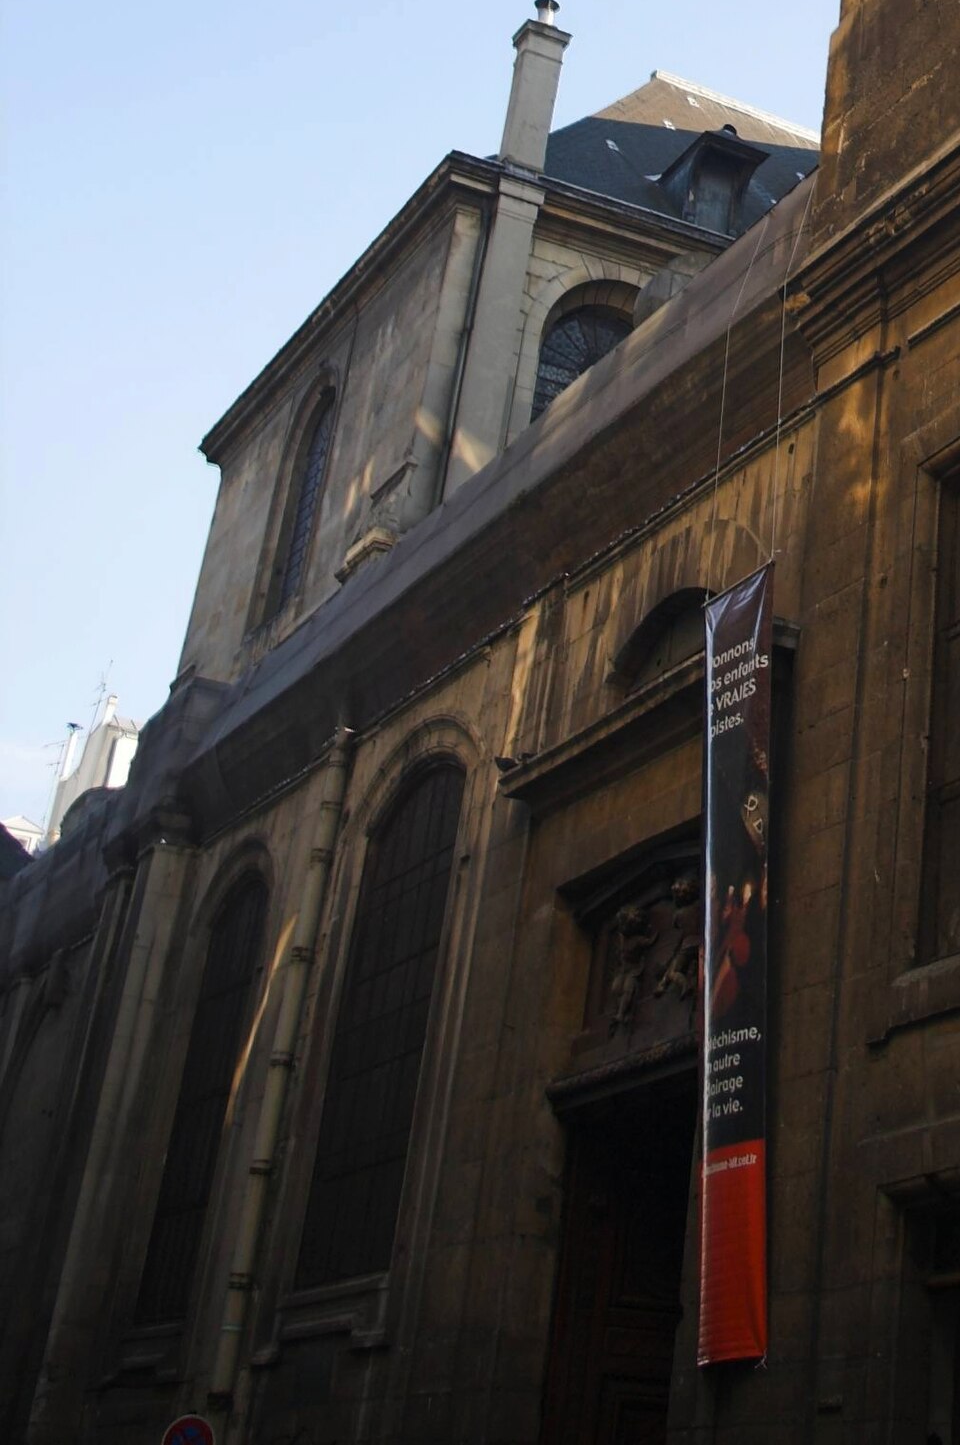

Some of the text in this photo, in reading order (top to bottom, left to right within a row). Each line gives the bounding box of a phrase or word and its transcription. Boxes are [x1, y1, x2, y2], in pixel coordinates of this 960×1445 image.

[711, 637, 755, 668] onnons
[724, 654, 769, 686] enfants
[716, 678, 757, 711] VRAIES
[708, 1027, 762, 1050] téchisme,
[713, 1053, 741, 1071] autre
[712, 1103, 721, 1118] la
[722, 1098, 743, 1115] vie.
